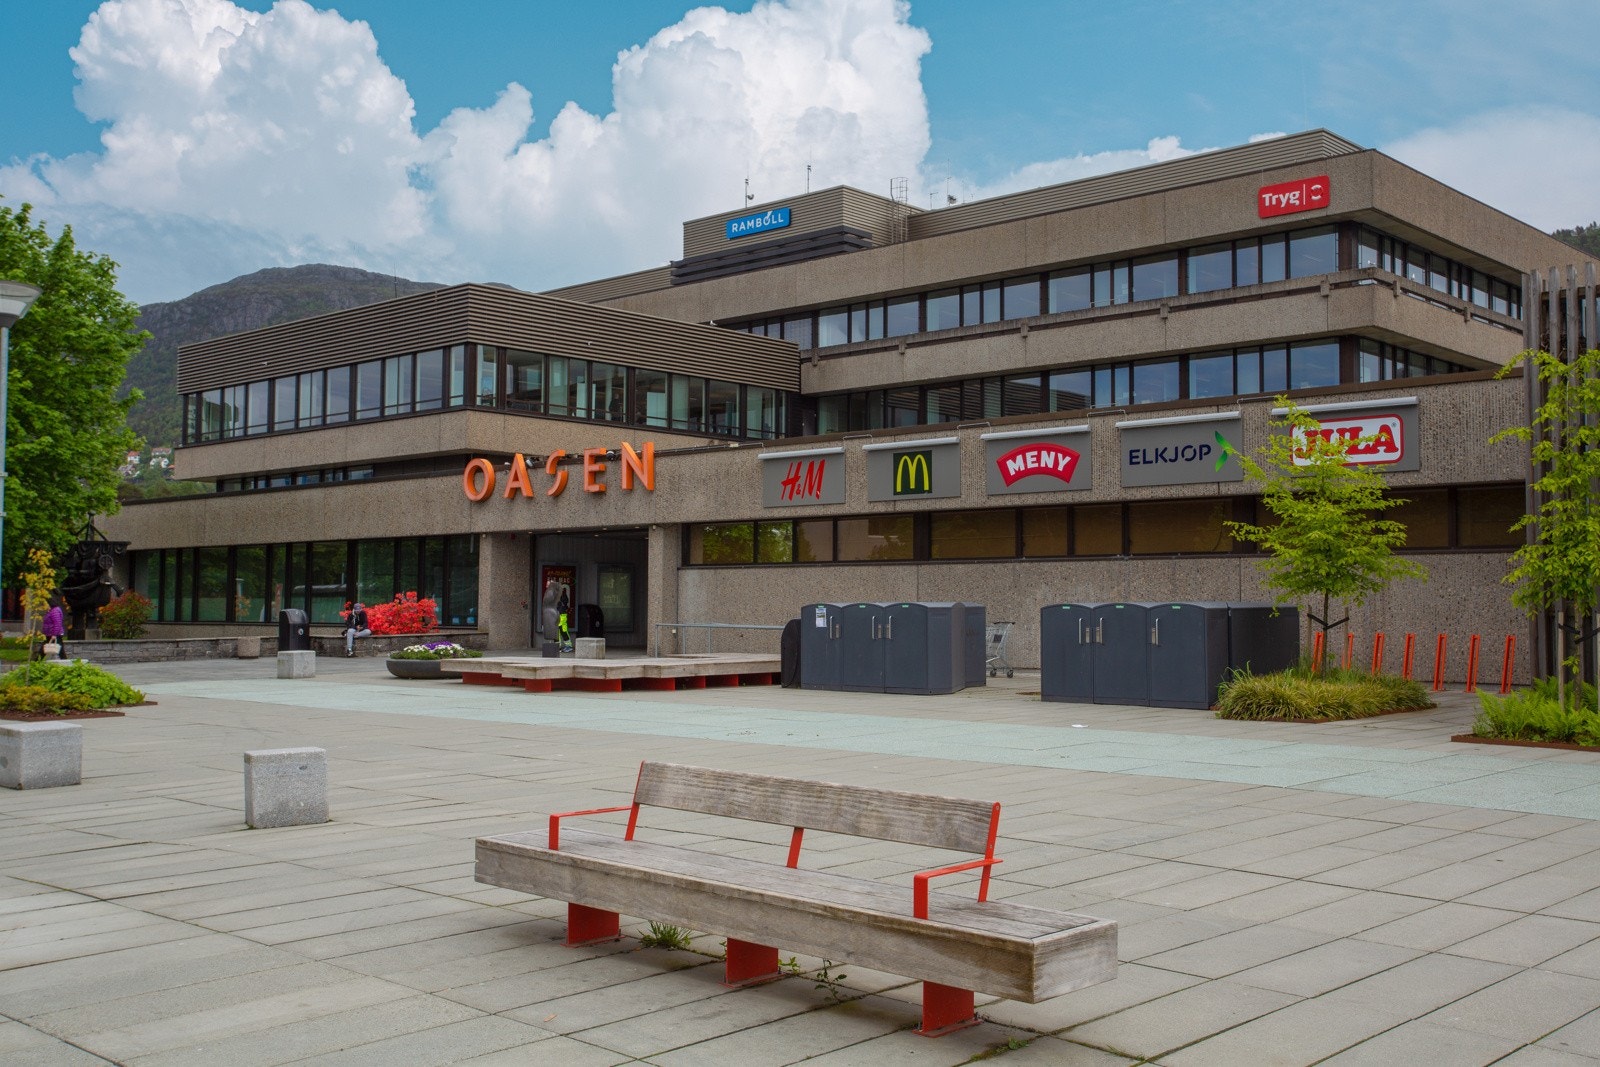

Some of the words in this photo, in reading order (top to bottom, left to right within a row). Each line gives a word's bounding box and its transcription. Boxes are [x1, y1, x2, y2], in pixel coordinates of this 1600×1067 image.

[1262, 190, 1300, 208] Tryg
[463, 441, 655, 501] OASEN
[780, 459, 826, 501] H&M
[1006, 450, 1072, 476] MENY
